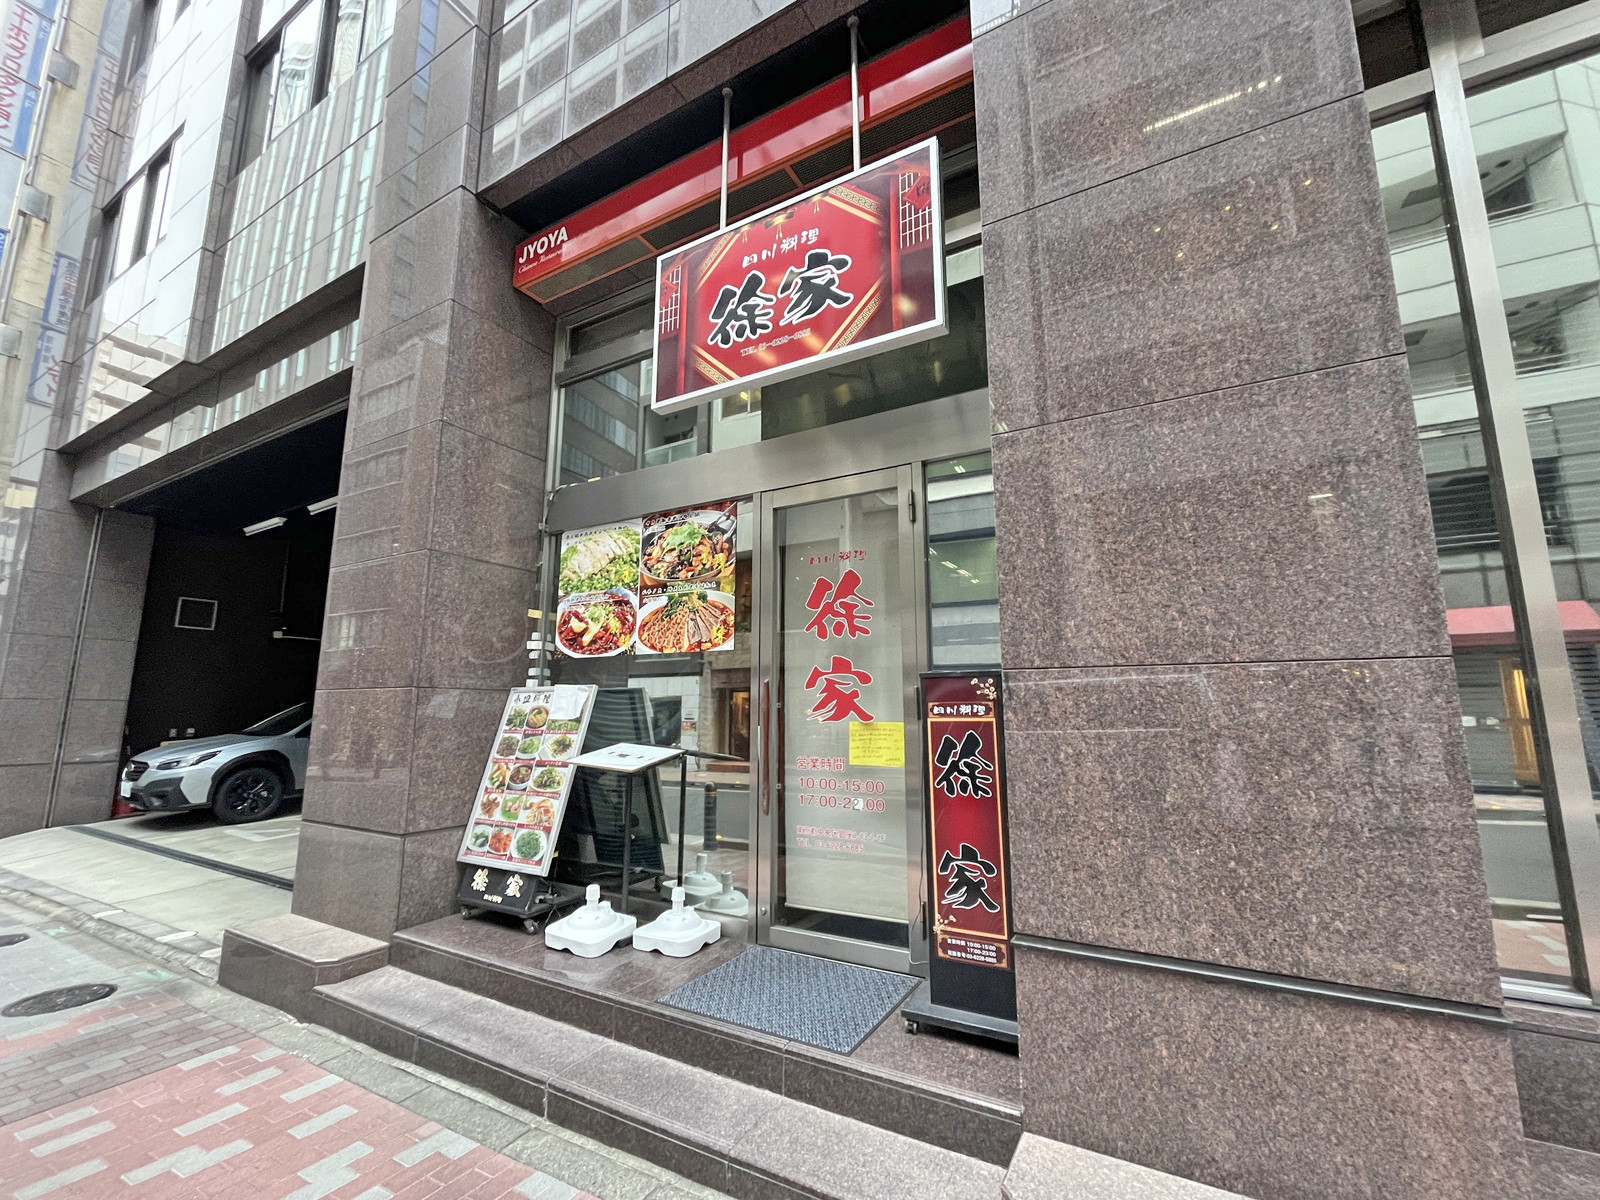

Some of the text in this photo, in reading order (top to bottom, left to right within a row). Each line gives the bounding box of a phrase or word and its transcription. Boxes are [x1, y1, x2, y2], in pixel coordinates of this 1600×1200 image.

[518, 226, 568, 263] JYOYA
[742, 228, 819, 268] 四川料理
[707, 249, 854, 348] 徐家
[810, 550, 866, 565] 四川料理
[804, 568, 875, 723] 徐家
[933, 704, 986, 716] 四川料理
[796, 756, 846, 772] 営業時間
[799, 777, 886, 794] 10:00-15:00
[935, 730, 1000, 913] 徐家
[797, 837, 812, 848] TEL
[471, 868, 524, 898] 徐家
